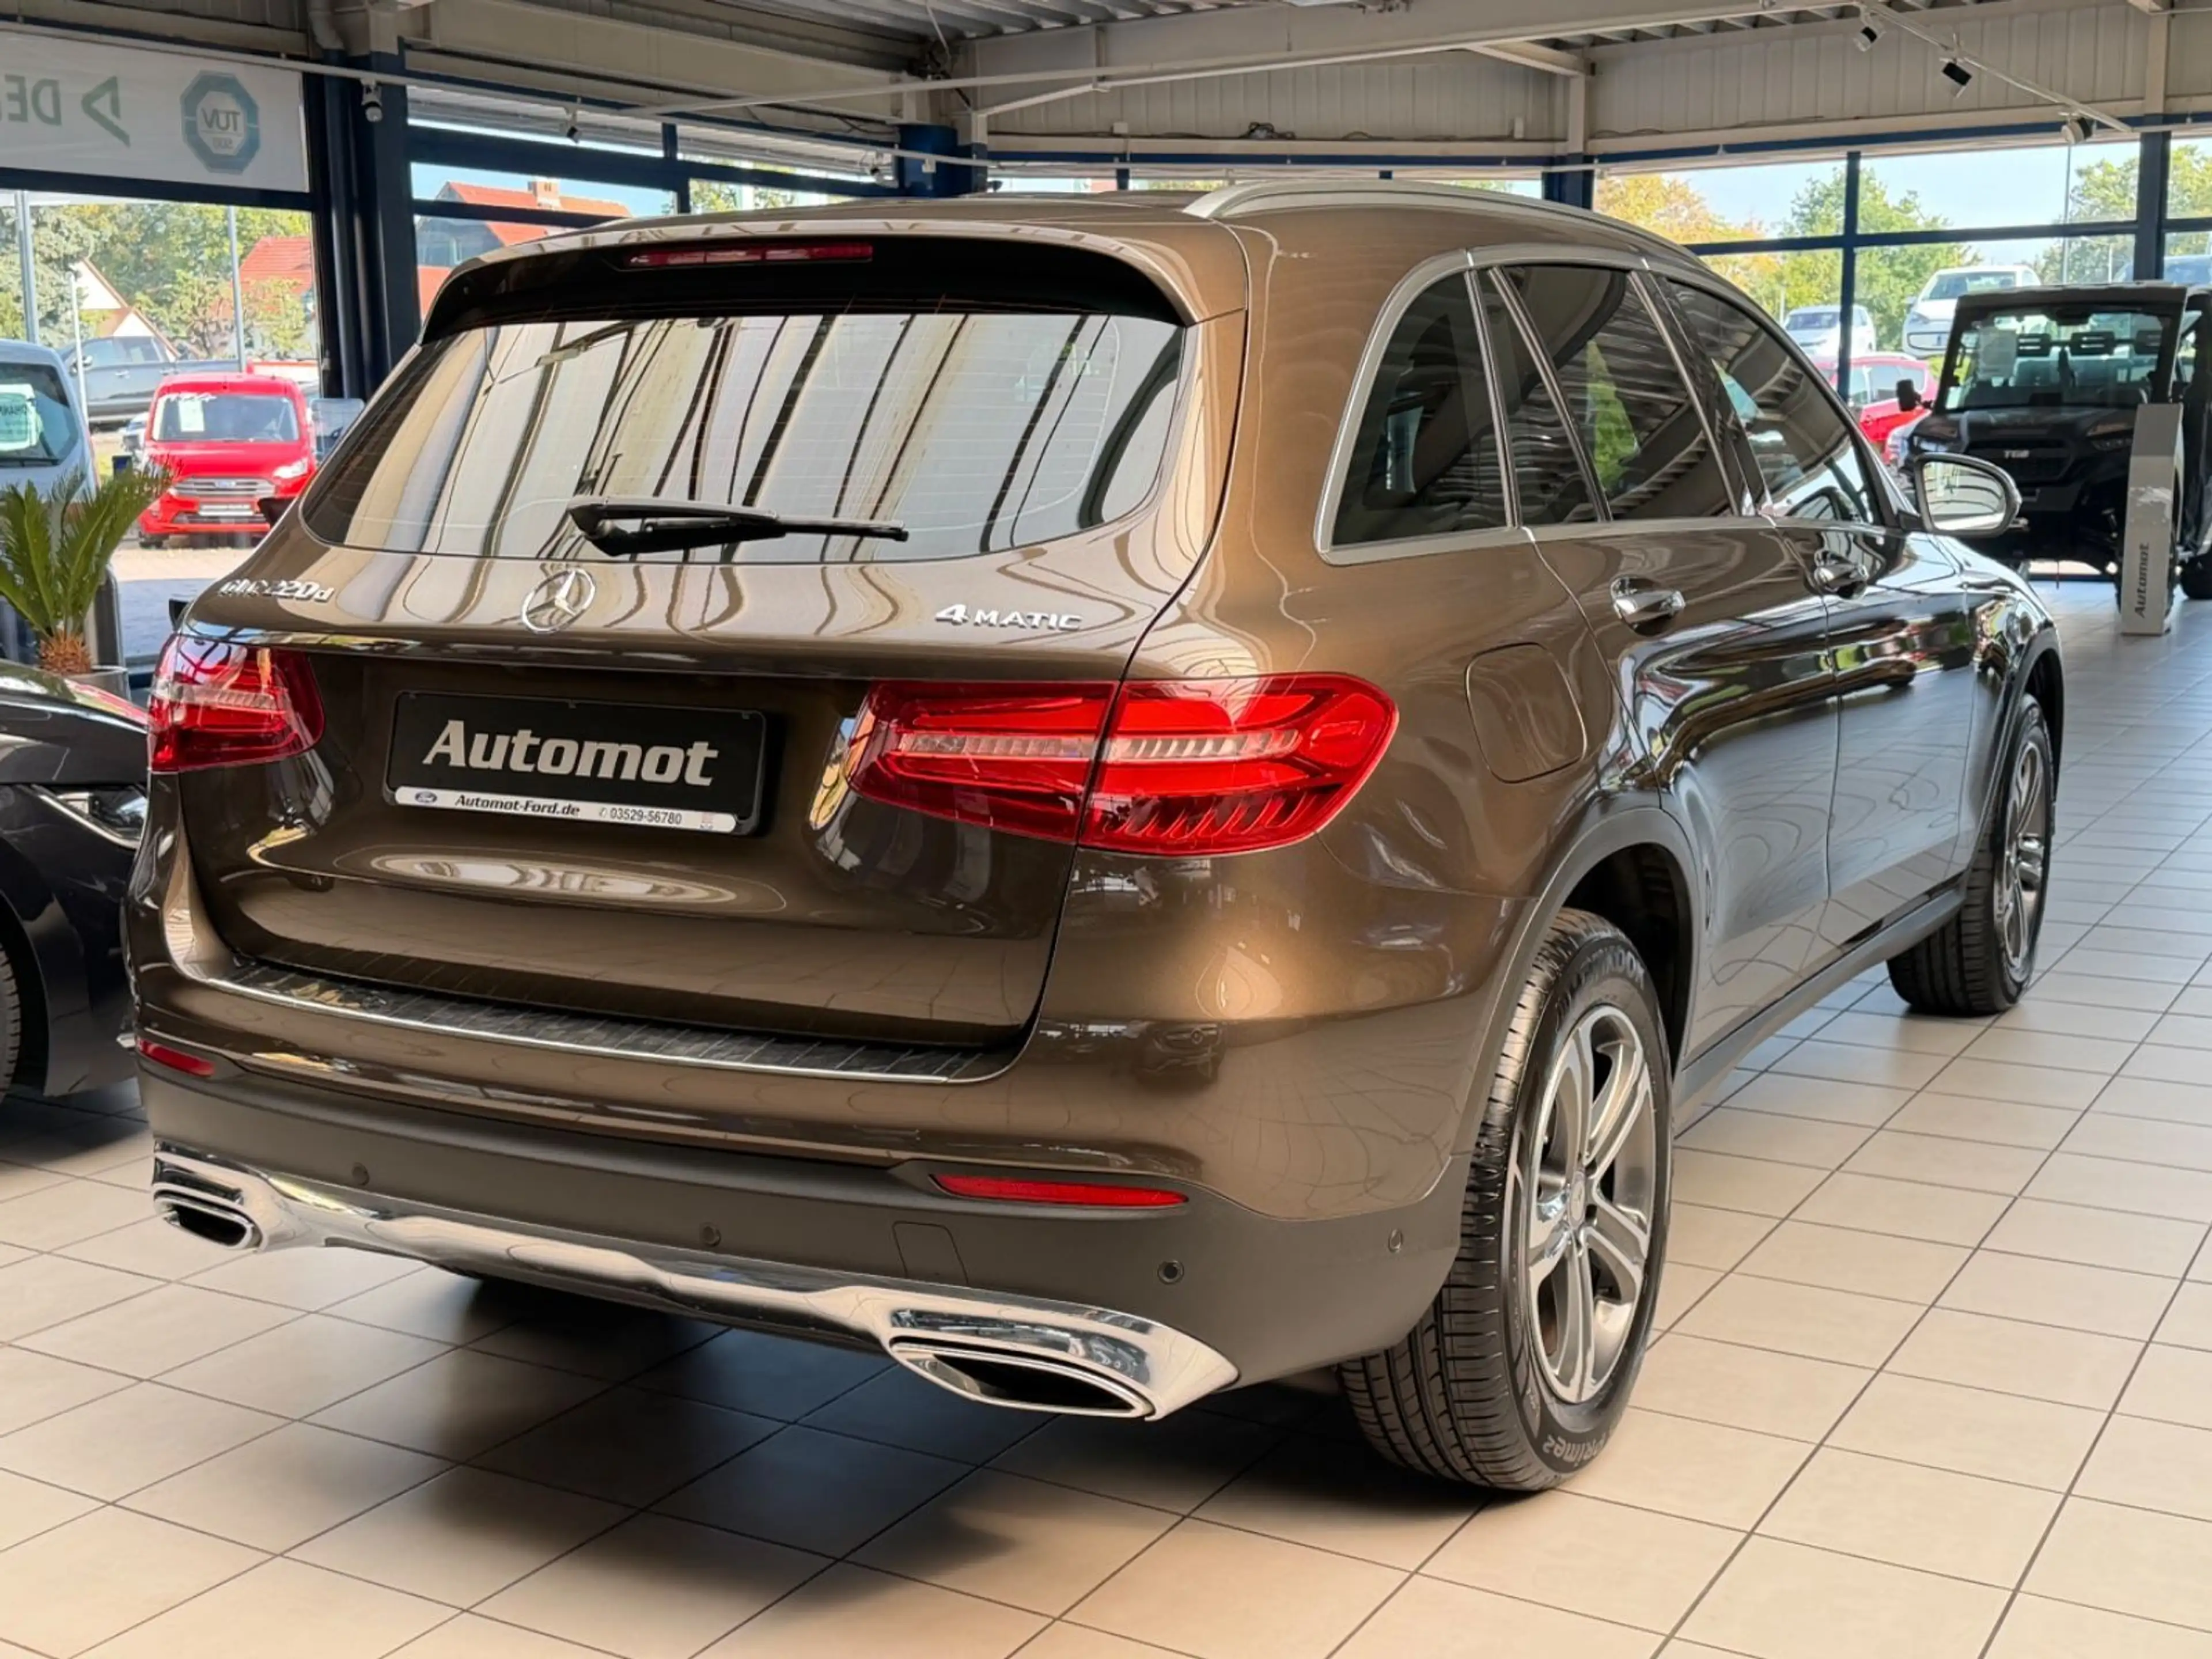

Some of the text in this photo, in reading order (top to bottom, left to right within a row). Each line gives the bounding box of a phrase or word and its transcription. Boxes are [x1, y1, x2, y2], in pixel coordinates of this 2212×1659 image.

[2135, 542, 2149, 619] Automot
[422, 720, 718, 786] Automot
[454, 794, 580, 816] Automot-Ford.de
[610, 808, 683, 825] 03529-56780
